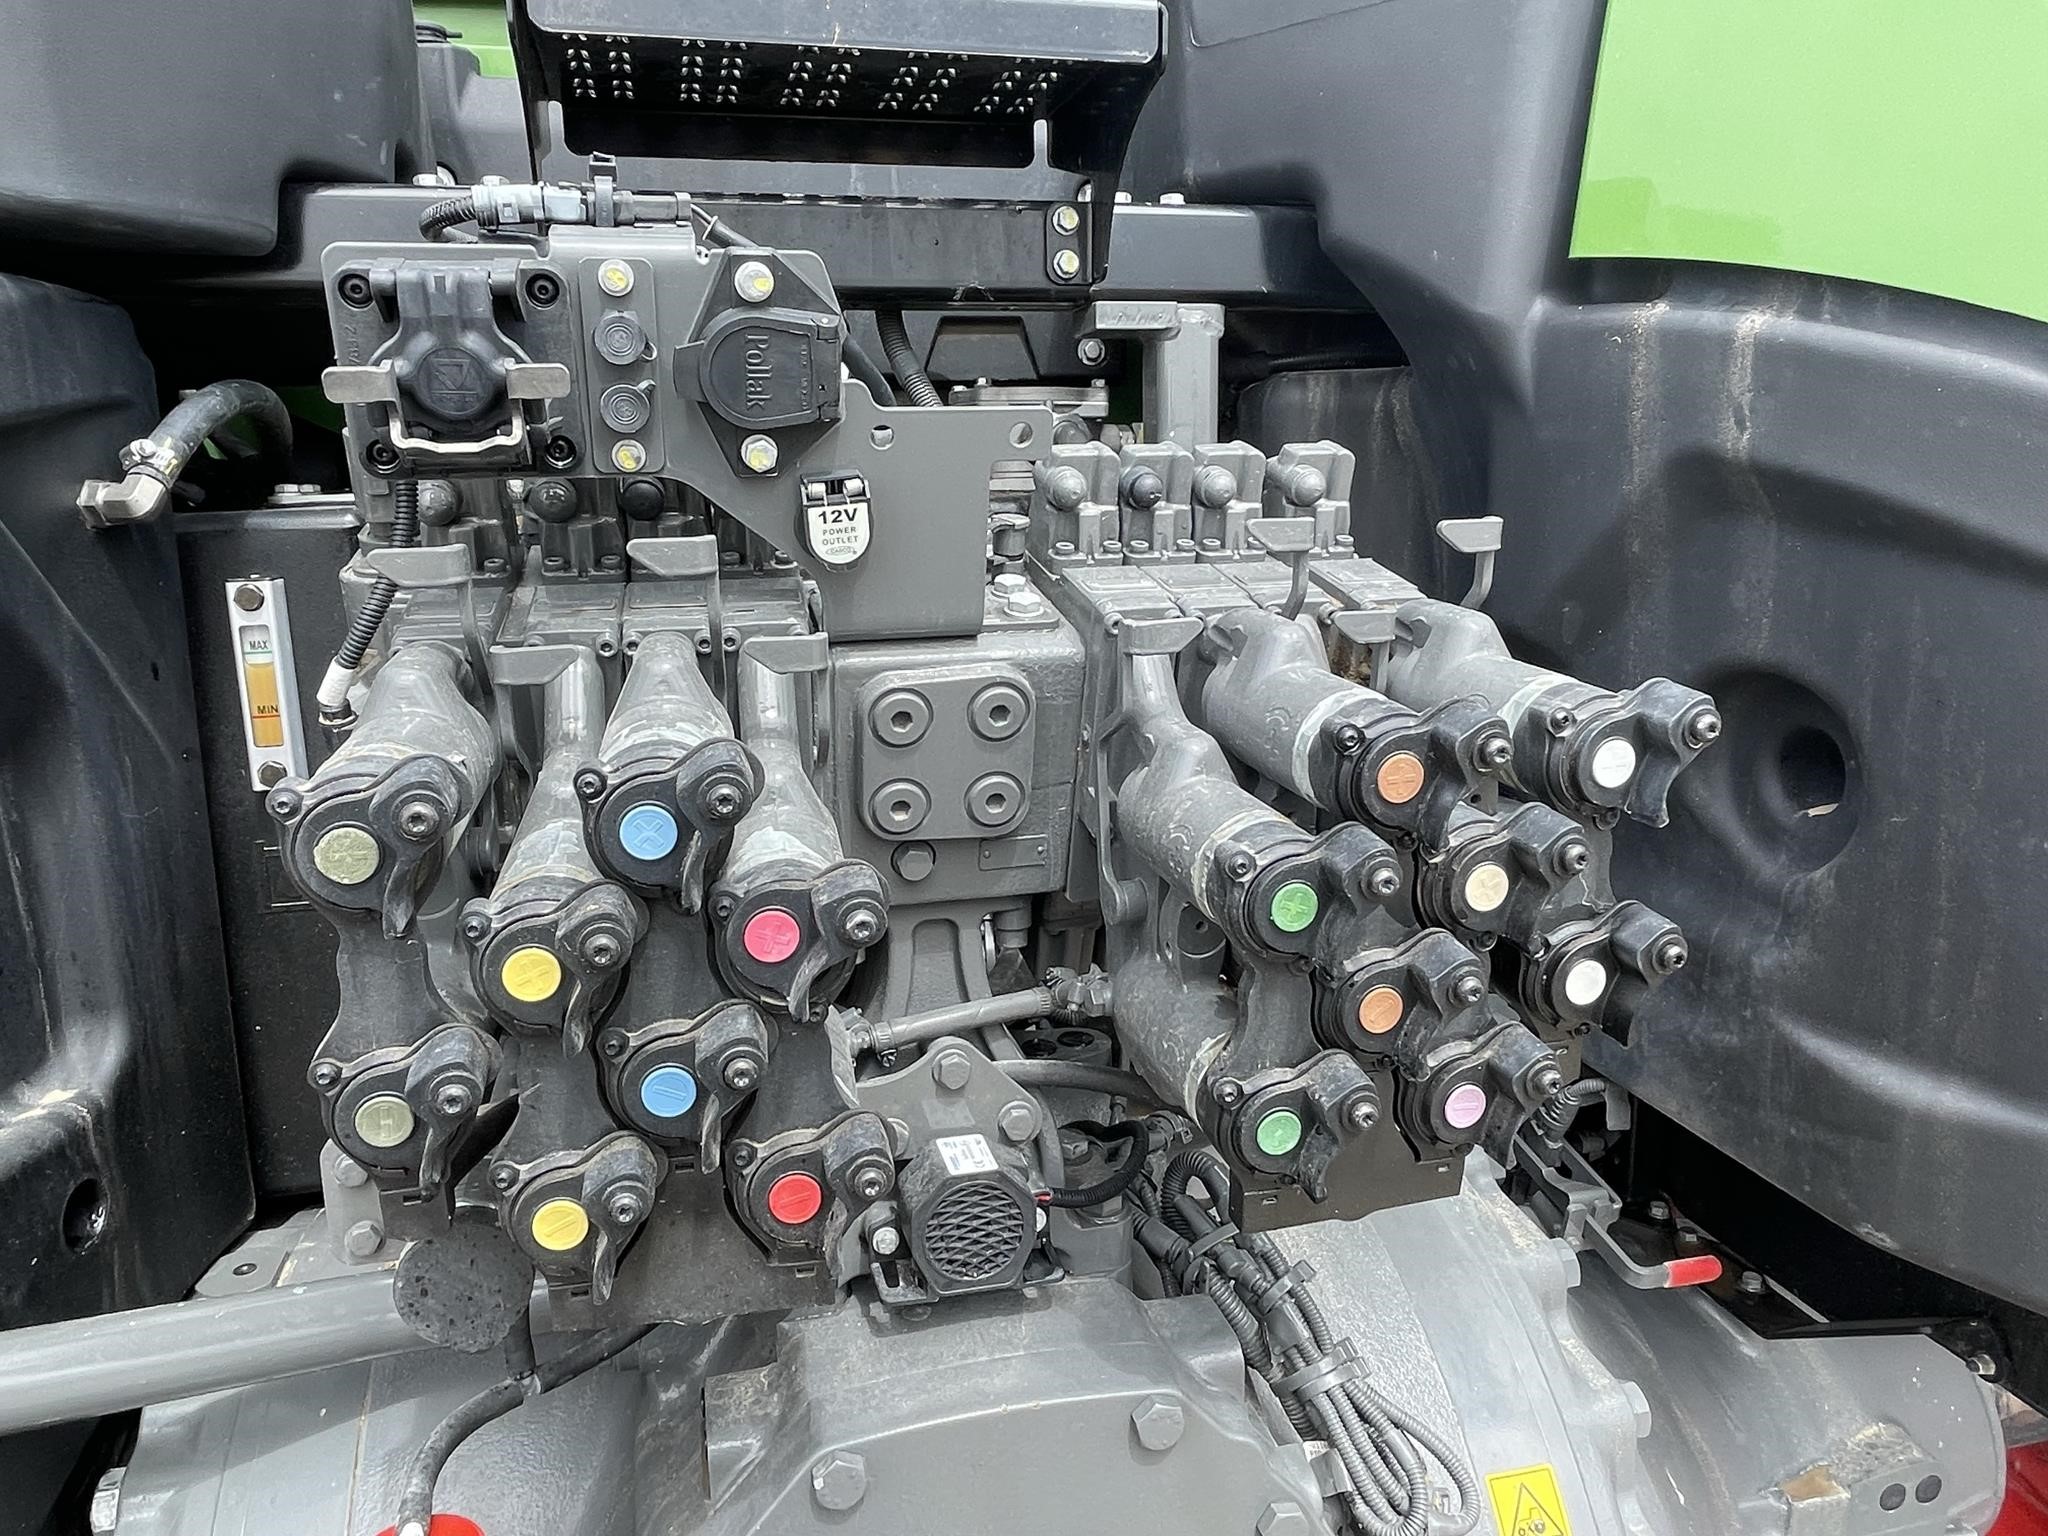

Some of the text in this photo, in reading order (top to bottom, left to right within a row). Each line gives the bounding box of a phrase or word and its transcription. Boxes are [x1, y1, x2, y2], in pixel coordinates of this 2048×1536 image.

[744, 333, 774, 411] Pollak
[818, 507, 858, 525] 12V
[822, 526, 857, 536] POWER
[822, 536, 858, 546] OUTLET
[249, 640, 269, 650] MAX
[257, 705, 279, 715] MIN
